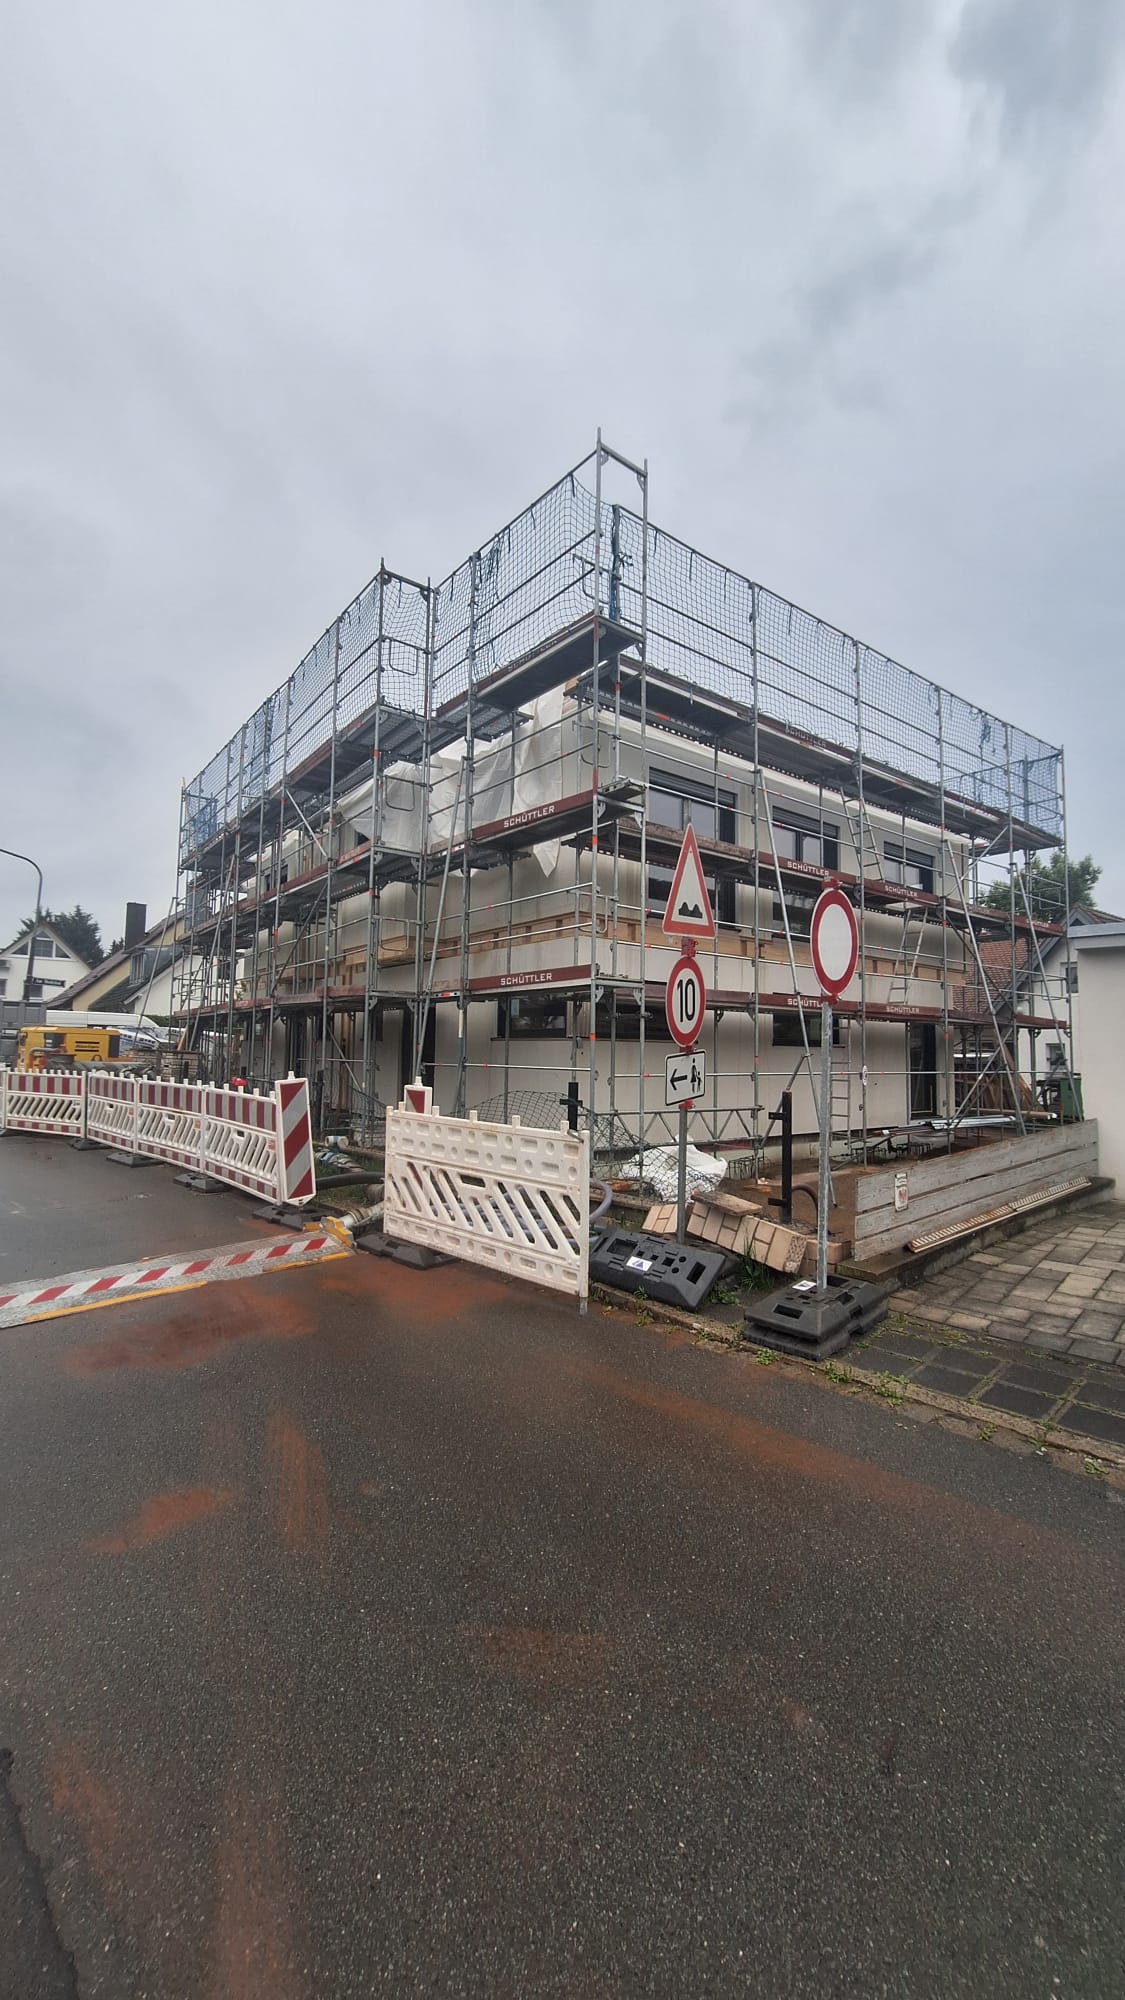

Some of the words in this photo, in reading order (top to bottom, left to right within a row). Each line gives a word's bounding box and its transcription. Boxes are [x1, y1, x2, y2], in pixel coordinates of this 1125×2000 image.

[503, 805, 555, 828] SCHÜTTLER
[787, 860, 830, 876] SCHÜTTLER
[884, 885, 918, 897] SCHÜTTLER
[500, 972, 553, 986] SCHÜTTLER
[677, 978, 696, 1023] 10
[787, 998, 822, 1008] SCHÜTTL
[886, 1005, 920, 1014] SCHÜTTLER
